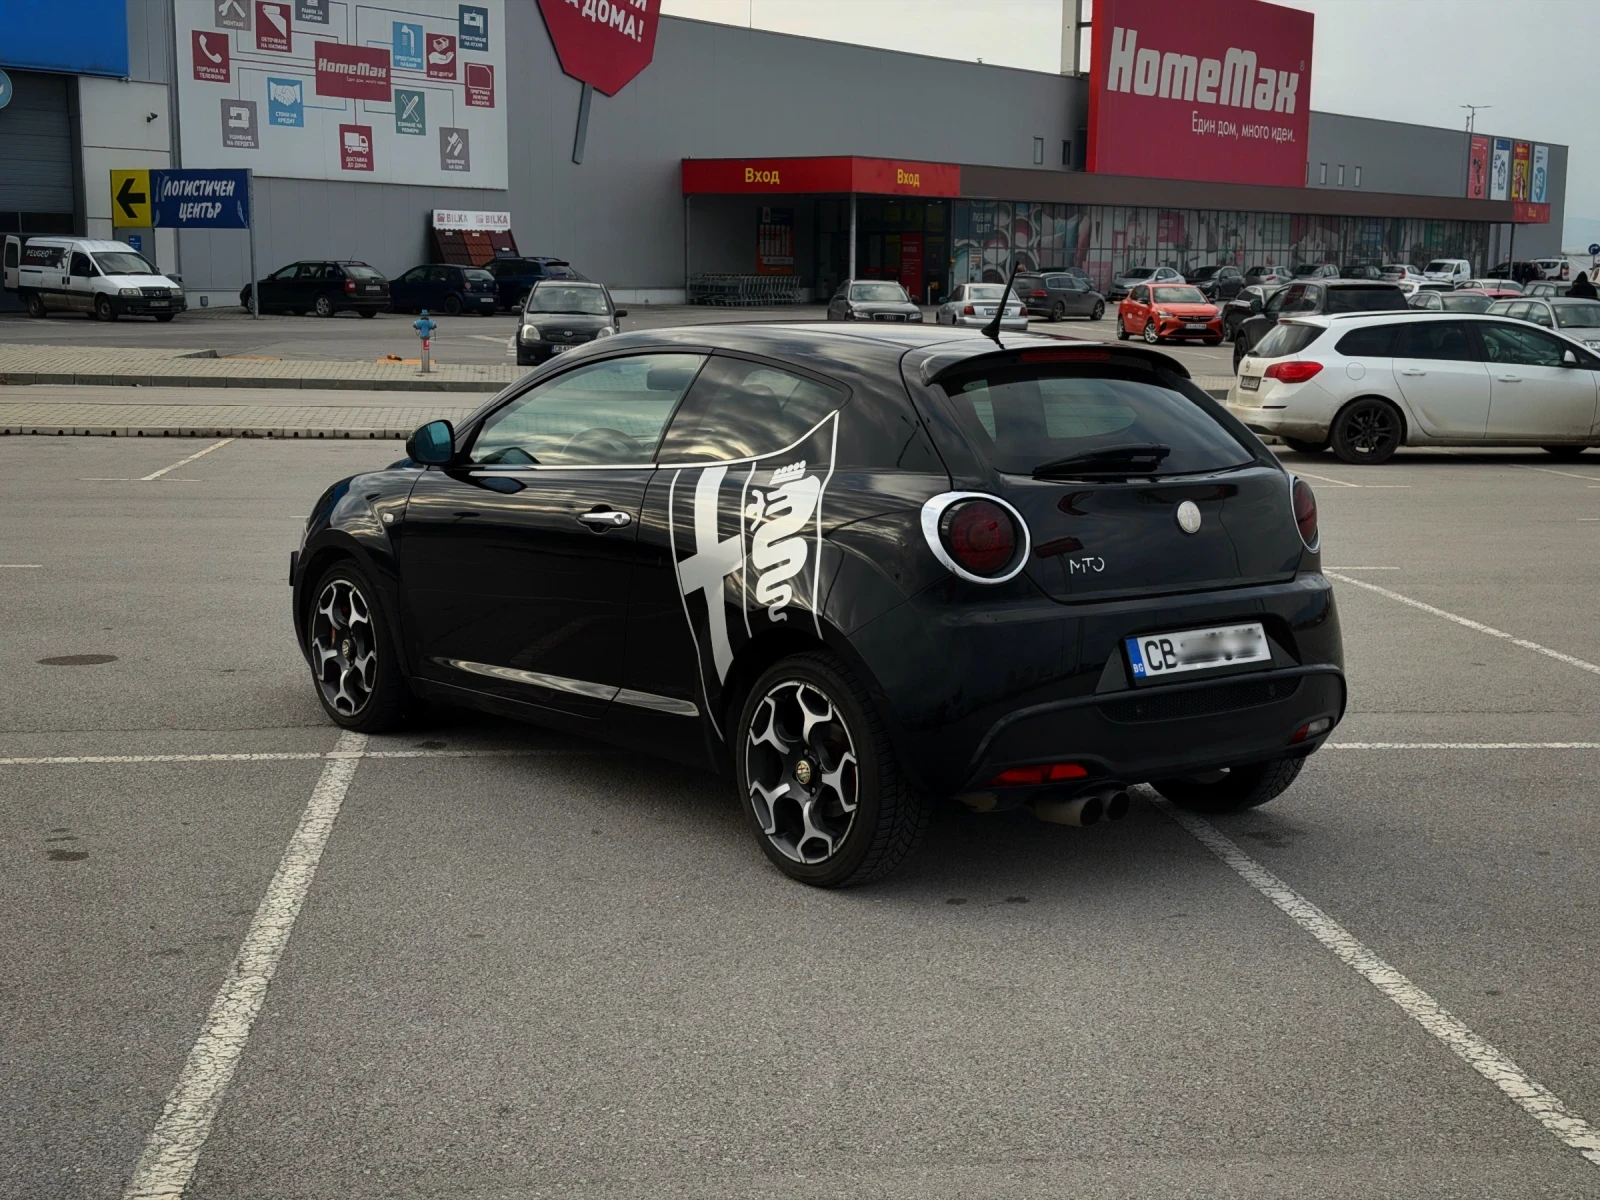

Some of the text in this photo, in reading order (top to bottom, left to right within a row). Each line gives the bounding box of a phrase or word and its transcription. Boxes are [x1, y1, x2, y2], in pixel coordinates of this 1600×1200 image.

[582, 0, 644, 43] ДОМА!
[197, 66, 219, 74] ПОРЪЧКА
[199, 72, 224, 80] ТЕЛЕФОНА
[318, 57, 387, 78] HomeMax
[1107, 26, 1299, 115] HomeMax
[1192, 110, 1296, 143] Един дом, много идеи.
[745, 167, 780, 185] Вход
[897, 169, 920, 188] Вход
[164, 180, 236, 197] ЛОГИСТИЧЕН
[179, 202, 222, 222] ЦЕНТЪР
[446, 213, 468, 223] BILKA
[485, 214, 508, 224] BILKA
[1132, 662, 1145, 674] BG
